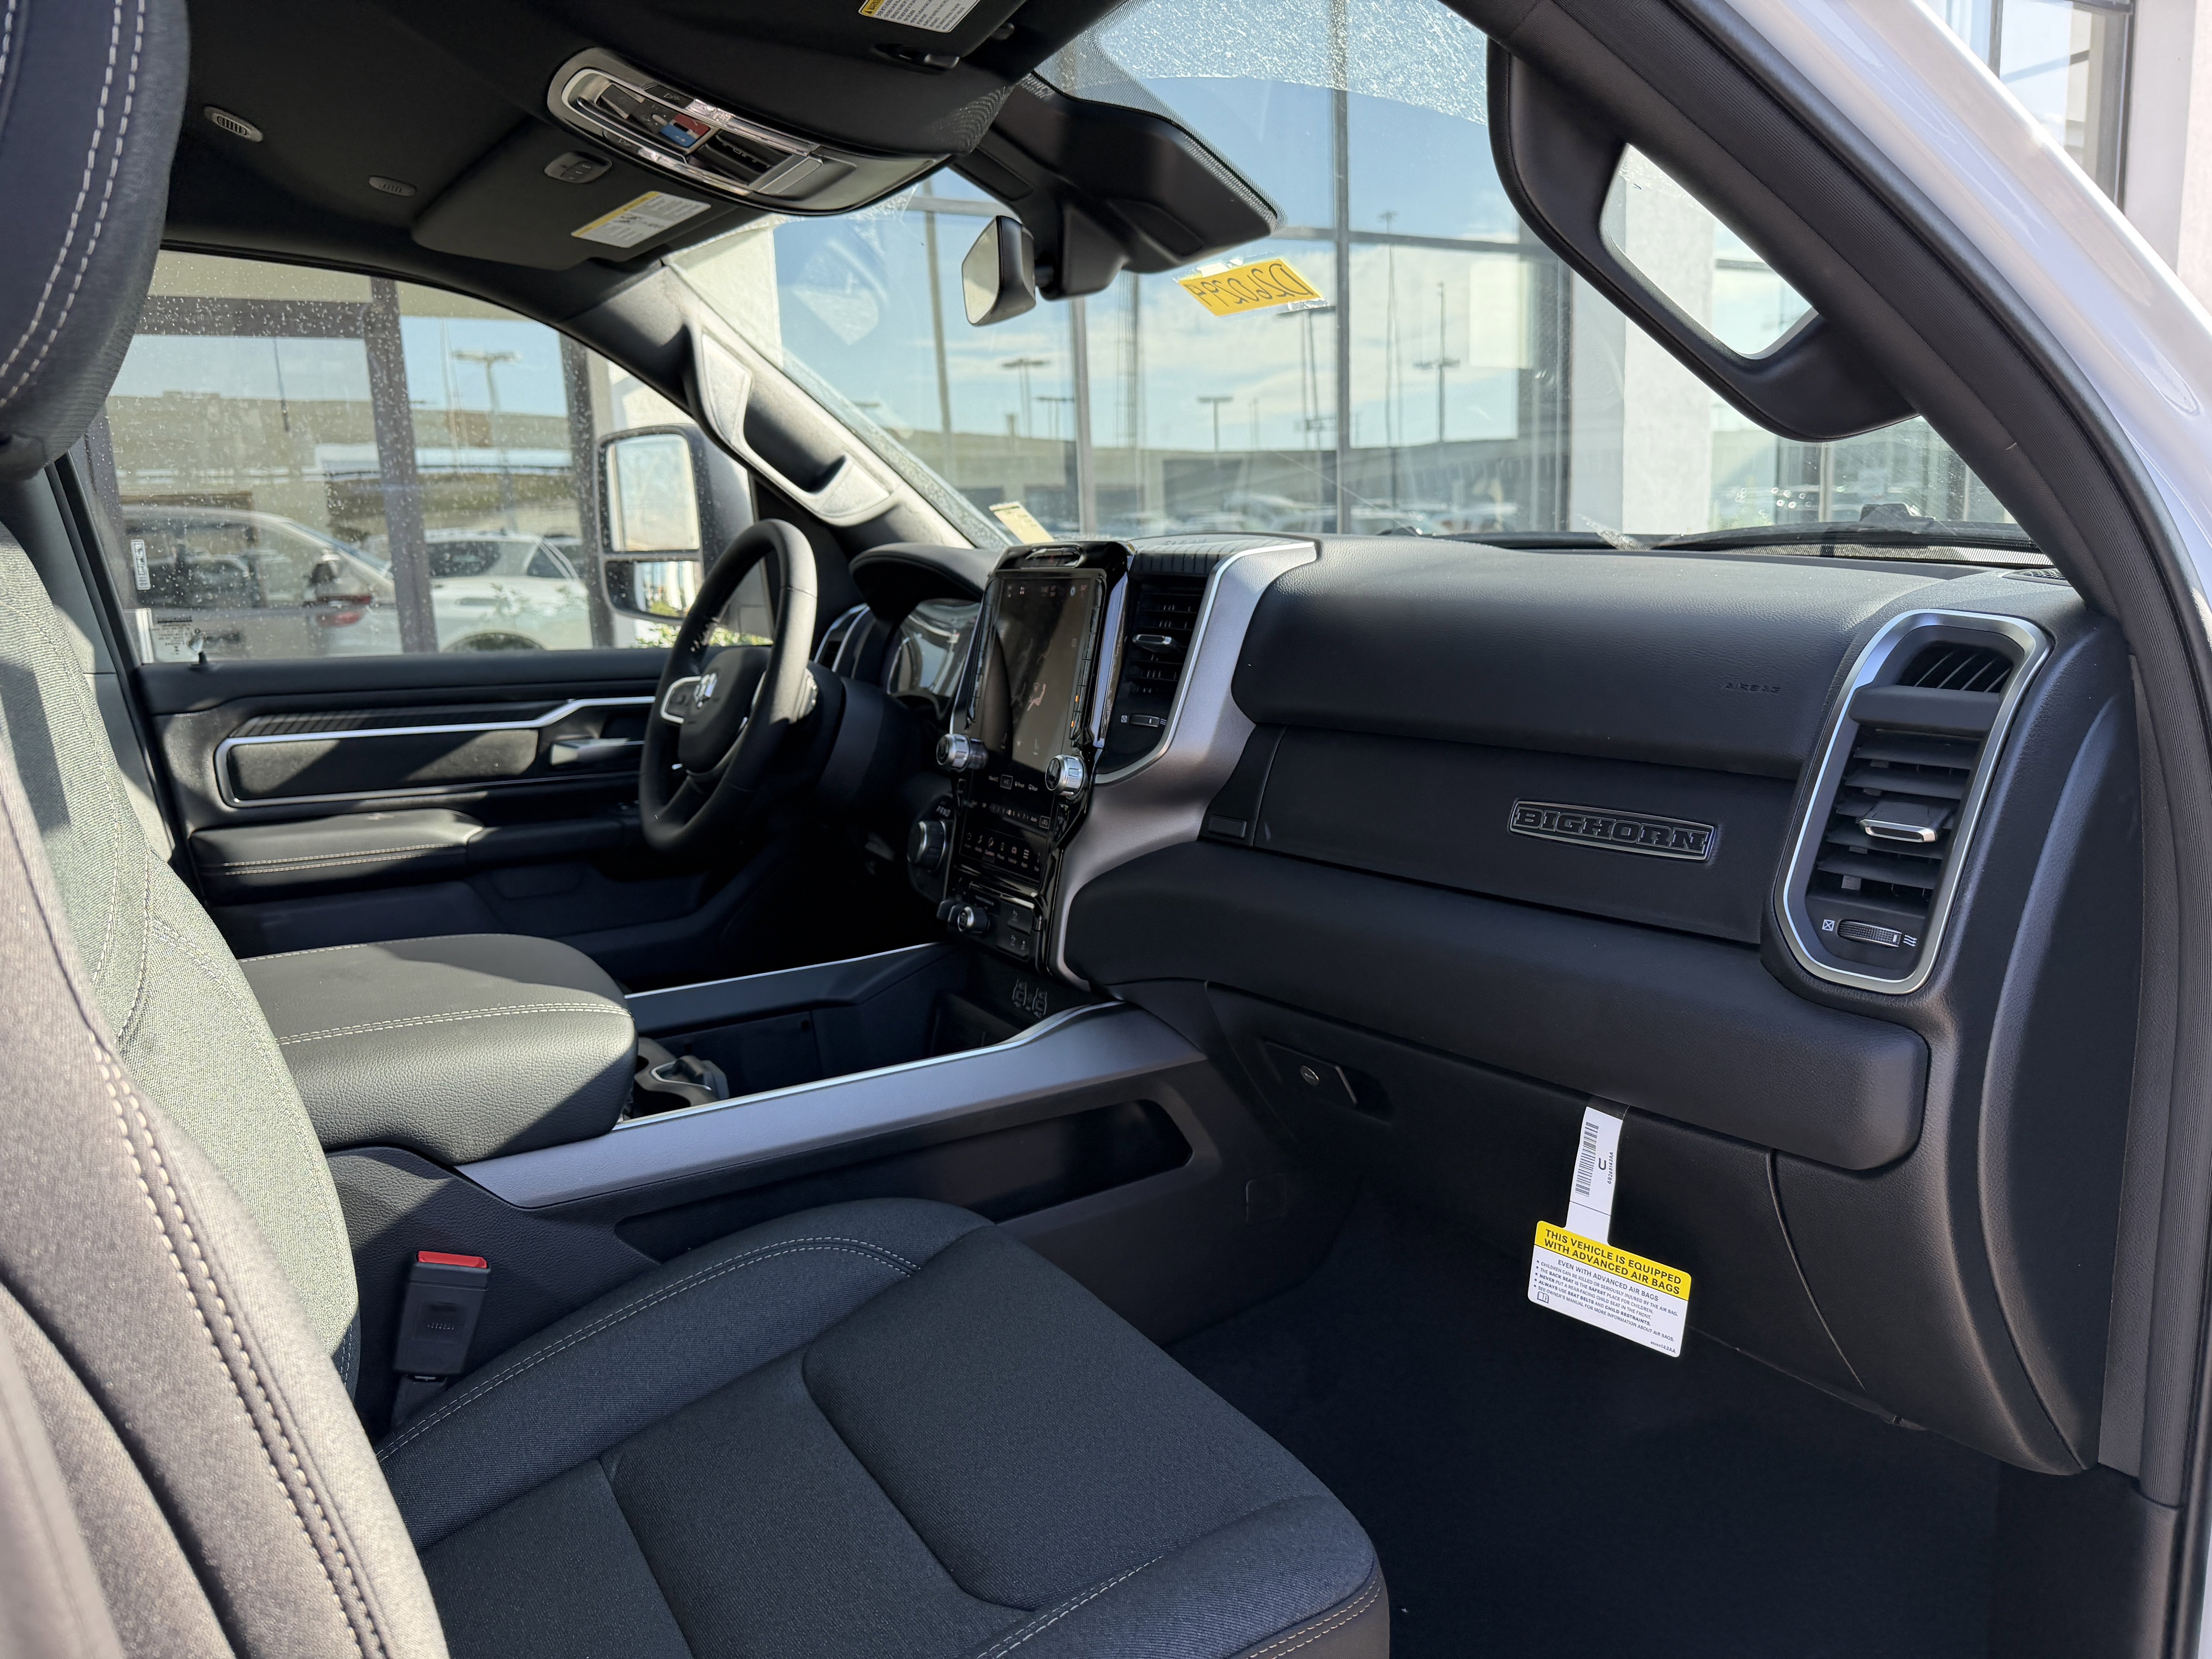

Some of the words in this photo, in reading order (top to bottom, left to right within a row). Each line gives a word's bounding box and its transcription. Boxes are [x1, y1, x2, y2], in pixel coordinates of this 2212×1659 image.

[1513, 806, 1709, 854] BIGHORN
[1544, 1238, 1570, 1255] WITH
[1571, 1250, 1628, 1275] ADVANCED
[1630, 1271, 1649, 1284] AIR
[1651, 1278, 1680, 1295] BAGS
[1546, 1229, 1568, 1243] THIS
[1570, 1238, 1613, 1261] VEHICLE
[1616, 1254, 1625, 1264] IS
[1628, 1259, 1681, 1284] EQUIPPED
[1539, 1274, 1555, 1283] NEVER
[1596, 1295, 1609, 1304] CHILD
[1539, 1280, 1558, 1290] ALWAYS
[1580, 1295, 1594, 1304] BELTS
[1605, 1305, 1620, 1314] CHILD
[1541, 1262, 1562, 1273] CHILDREN
[1578, 1275, 1593, 1285] KILLED
[1601, 1284, 1624, 1296] SERIOUSLY
[1625, 1293, 1643, 1303] INJURED
[1549, 1271, 1562, 1279] BACK
[1588, 1286, 1606, 1296] SAFEST
[1606, 1293, 1620, 1302] PLACE
[1558, 1259, 1574, 1270] EVEN
[1575, 1266, 1592, 1277] WITH
[1592, 1273, 1628, 1290] ADVANCED
[1628, 1286, 1640, 1295] AIR
[1641, 1290, 1659, 1301] BAGS
[1566, 1297, 1584, 1307] MANUAL
[1594, 1307, 1606, 1316] MORE
[1607, 1312, 1637, 1327] INFORMATION
[1637, 1324, 1652, 1333] ABOUT
